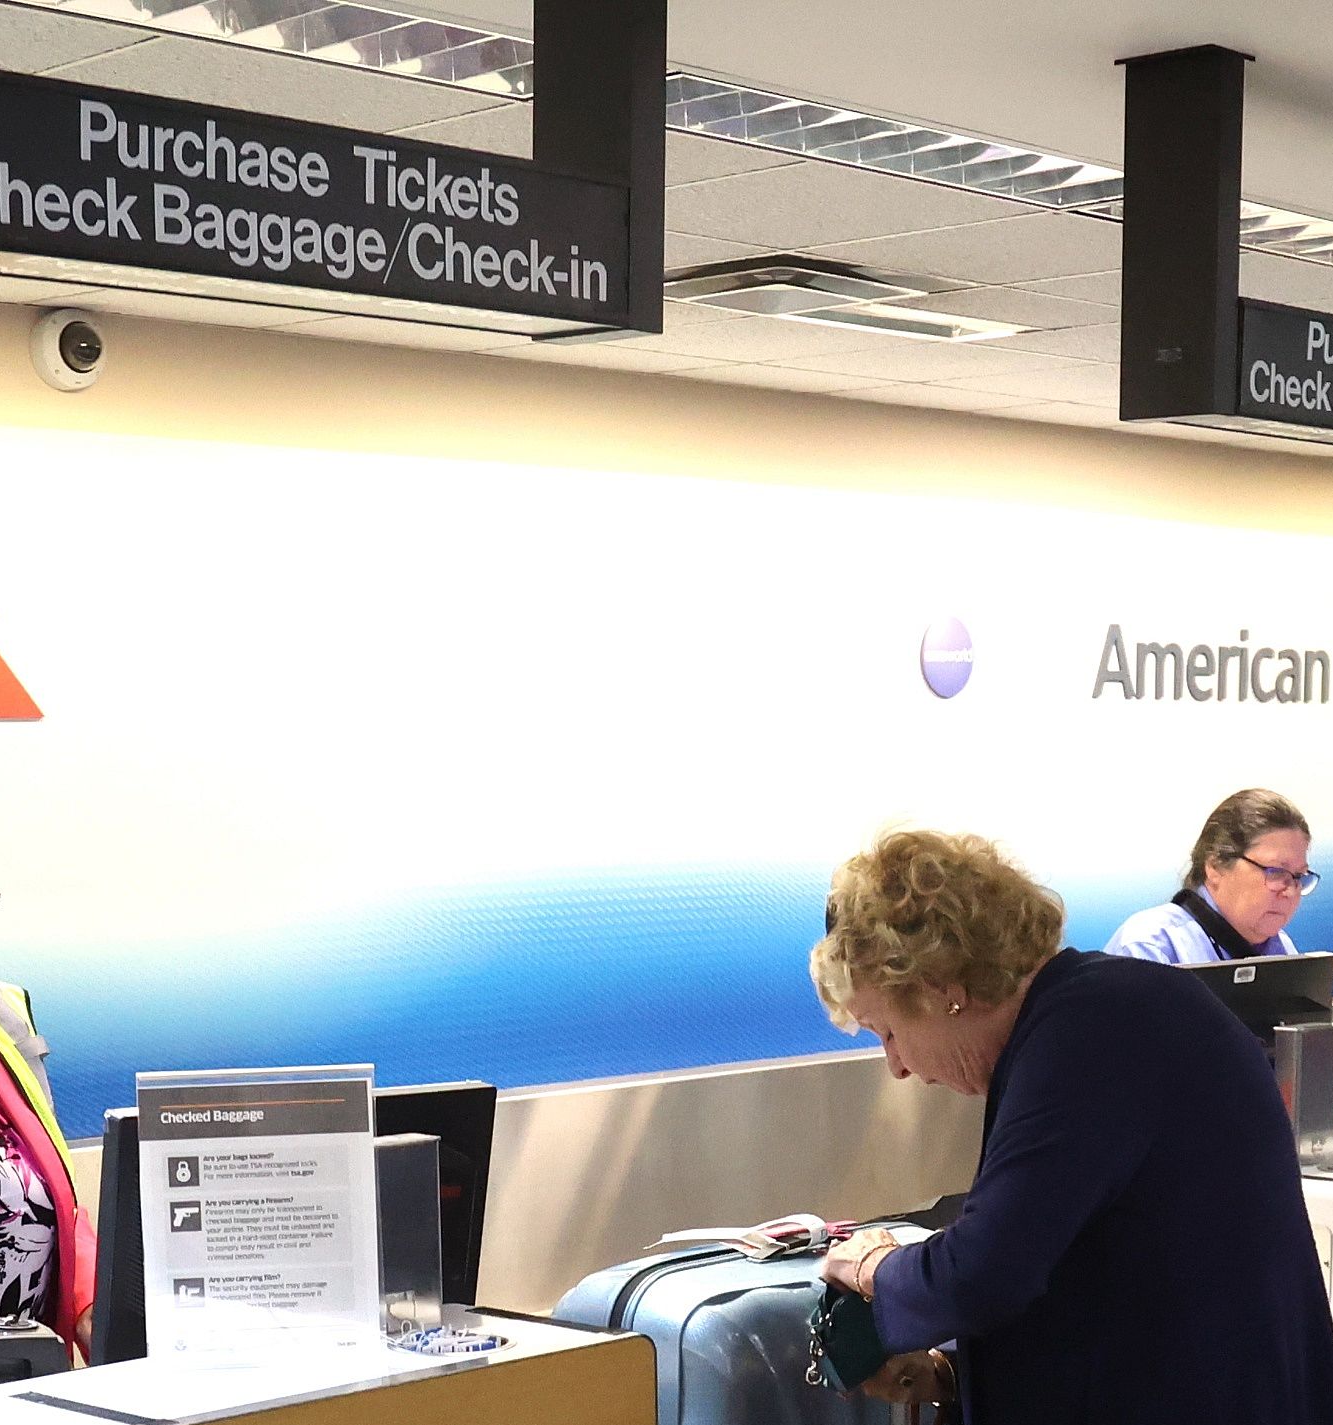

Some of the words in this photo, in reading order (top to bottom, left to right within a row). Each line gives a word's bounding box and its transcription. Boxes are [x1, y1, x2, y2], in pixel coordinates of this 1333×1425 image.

[79, 100, 330, 198] Purchase
[353, 145, 519, 226] Tickets
[153, 183, 608, 302] Baggage/Check-in
[1249, 359, 1332, 412] Check
[1091, 624, 1330, 705] American
[160, 1110, 210, 1124] Checked
[213, 1110, 264, 1122] Baggage
